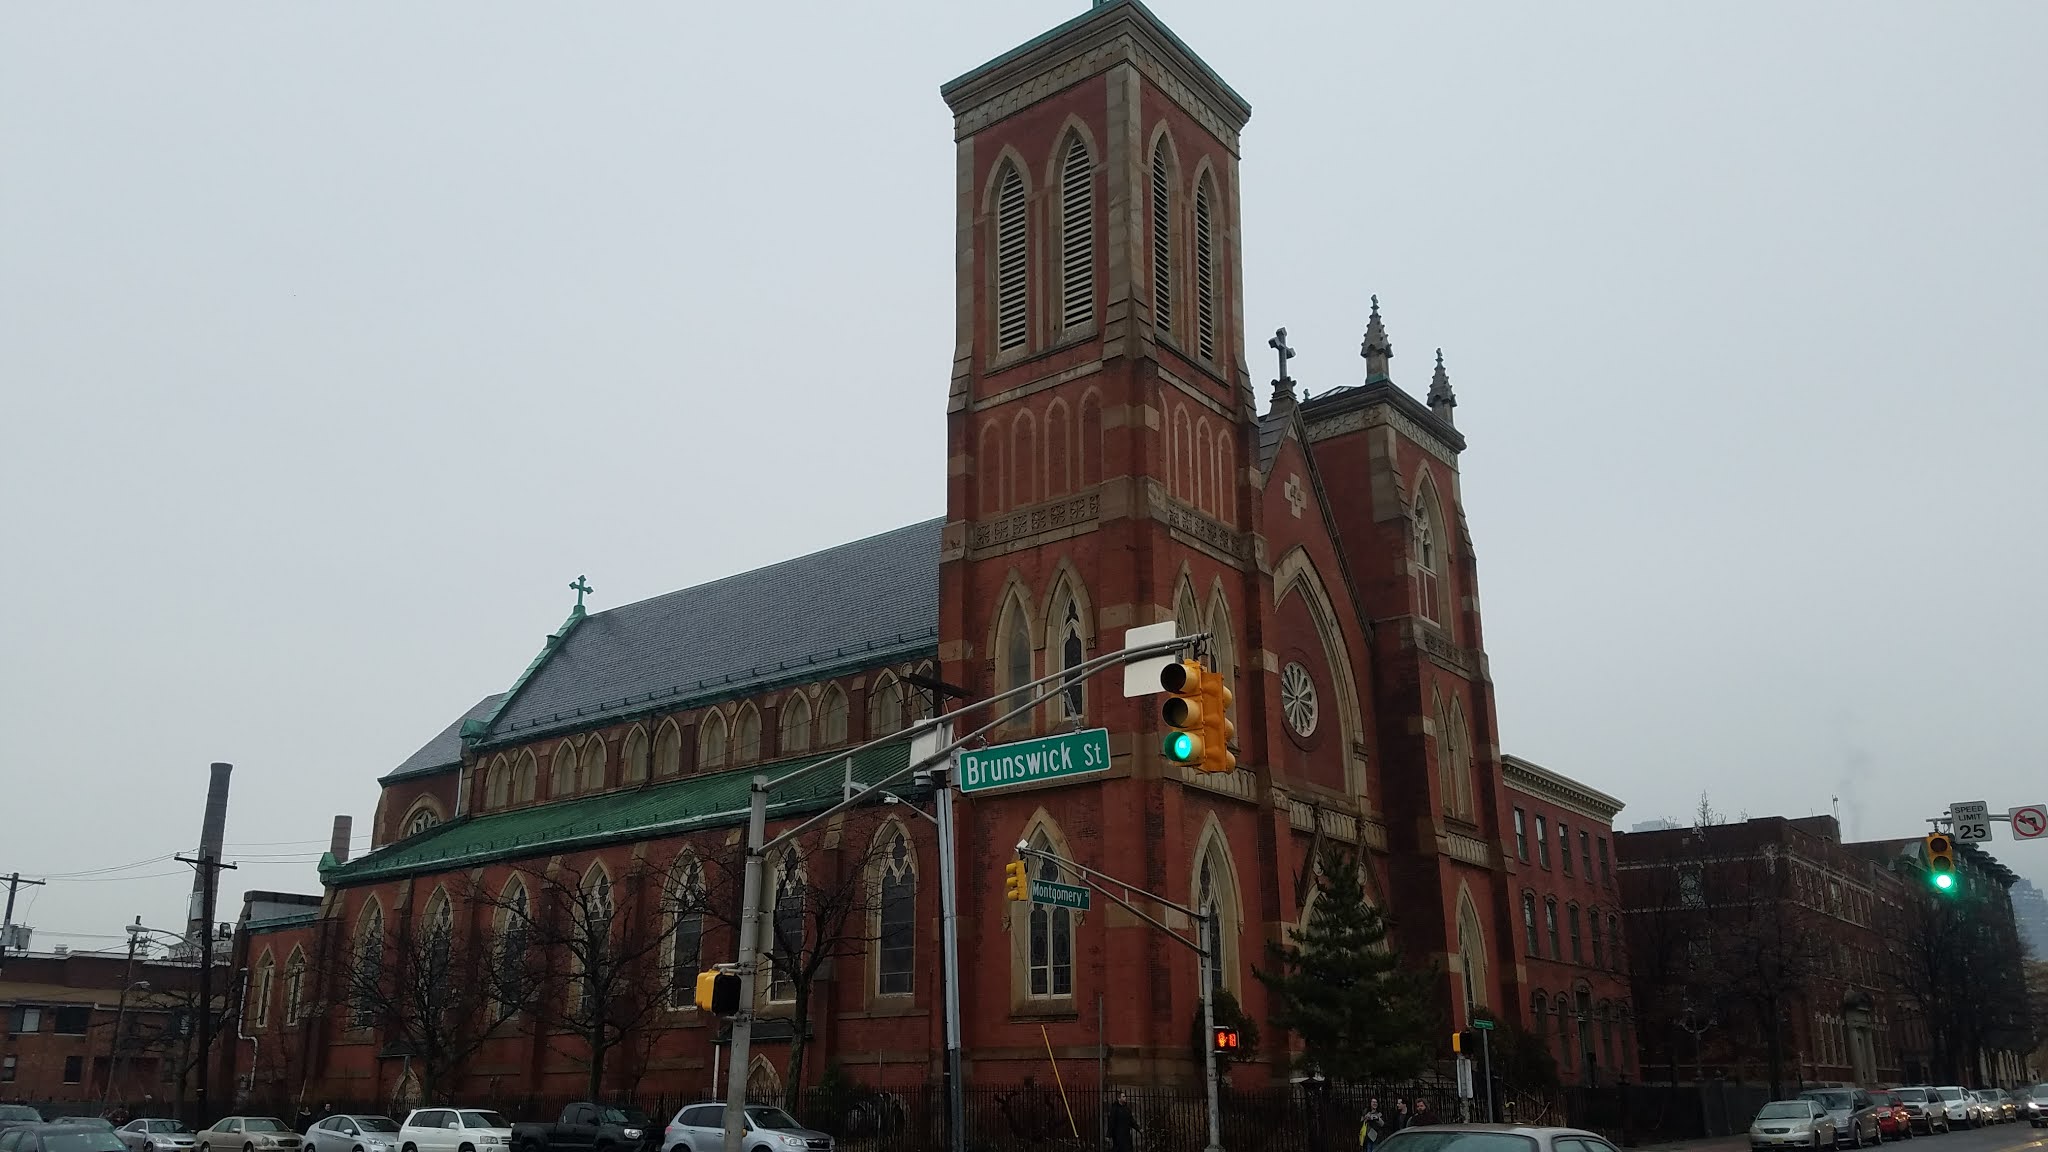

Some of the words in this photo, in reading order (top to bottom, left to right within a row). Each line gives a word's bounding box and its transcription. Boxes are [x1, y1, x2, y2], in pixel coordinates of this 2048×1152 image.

[966, 741, 1072, 785] Brunswick
[1083, 743, 1102, 766] St
[1955, 805, 1984, 814] SPEED
[1958, 813, 1982, 821] LIMIT
[1959, 824, 1986, 839] 25
[1033, 882, 1082, 906] Montgomery
